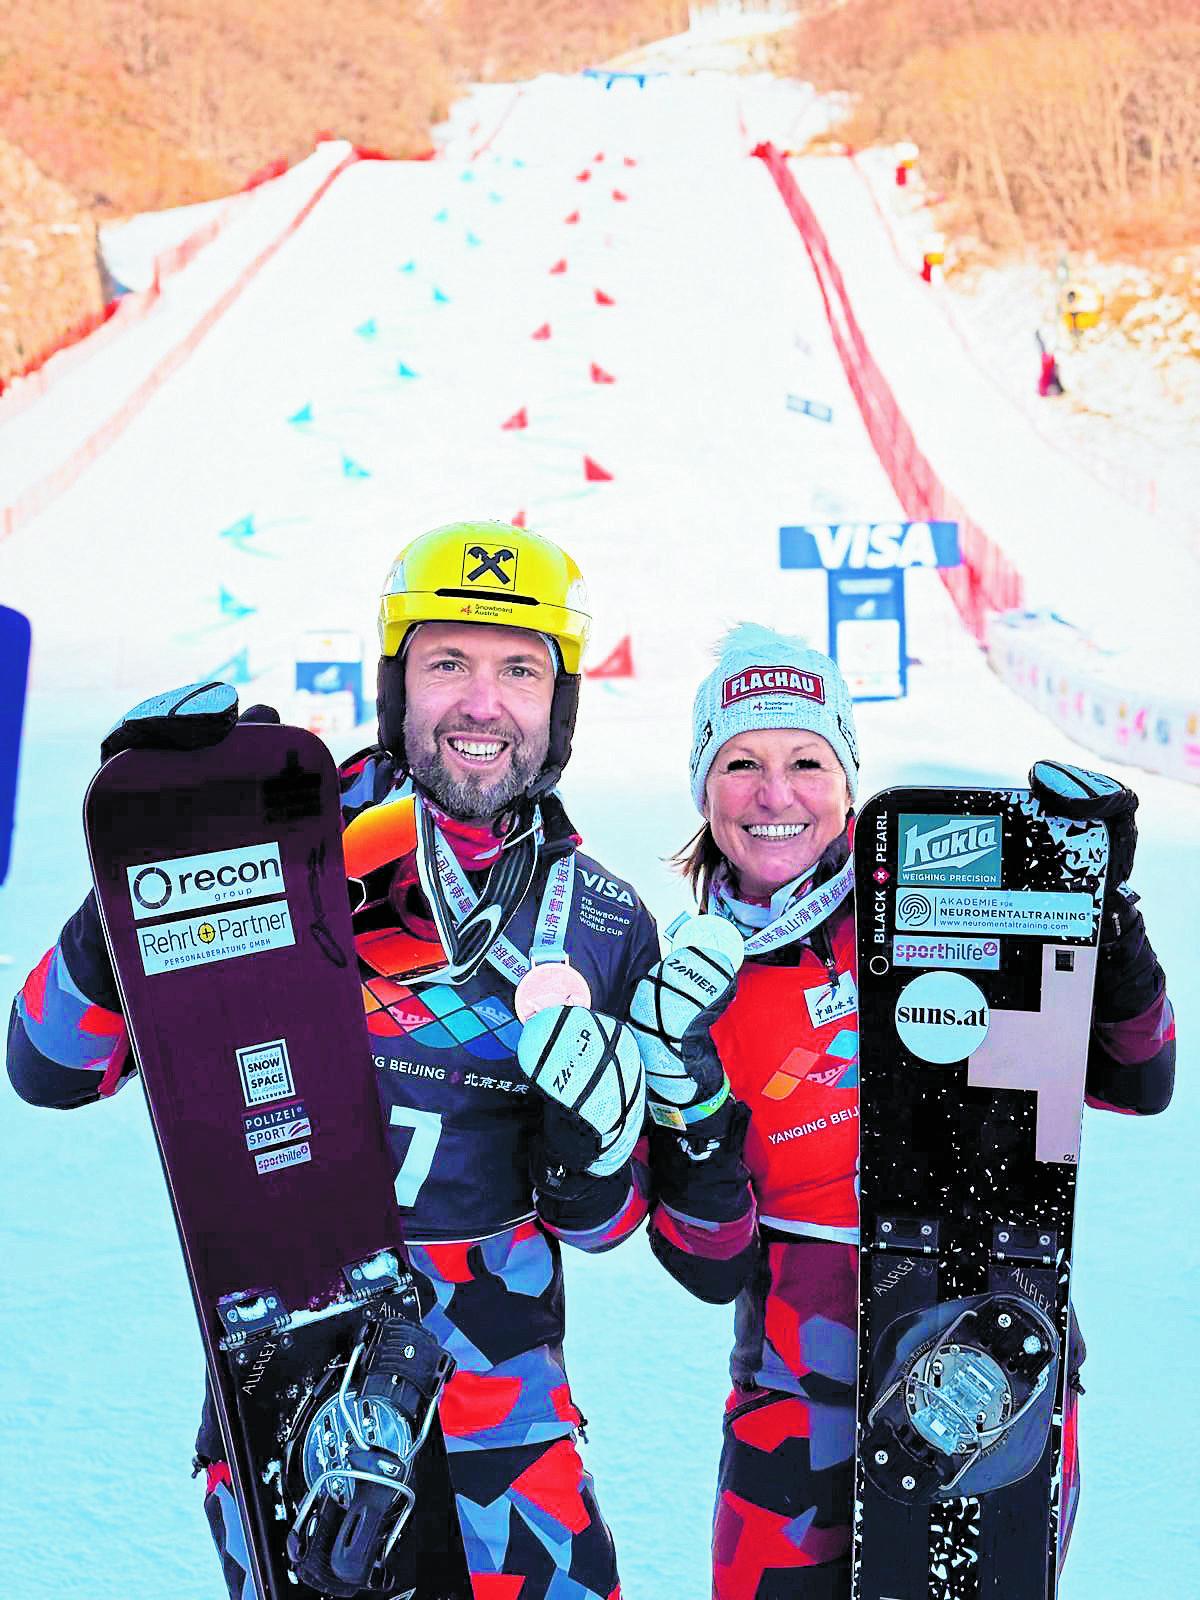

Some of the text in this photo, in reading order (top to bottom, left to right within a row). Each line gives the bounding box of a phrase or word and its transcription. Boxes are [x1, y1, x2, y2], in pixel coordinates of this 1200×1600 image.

[803, 522, 938, 569] VISA
[474, 603, 513, 614] Snowboard
[474, 609, 499, 617] Austria
[731, 671, 815, 696] FLACHAU
[902, 820, 998, 868] Kukla
[178, 857, 281, 895] recon
[576, 867, 635, 907] VISA
[873, 810, 888, 944] BLACK PEARL
[902, 873, 997, 883] WEIGHING PRECISION
[214, 886, 253, 901] group
[939, 897, 998, 907] AKADEMIE
[580, 903, 630, 925] SNOWBOARD
[580, 911, 605, 925] ALPINE
[939, 920, 1069, 930] www.neuromentaltraining.com
[142, 911, 287, 957] Rehrl Partner
[579, 916, 623, 937] WORLD CUP
[164, 938, 271, 966] PERSONALBERATUNG GMBH
[895, 943, 984, 962] sporthilfe
[897, 1005, 988, 1027] suns.at
[247, 1057, 281, 1073] SNOW
[389, 1059, 446, 1080] BEIJING
[250, 1072, 284, 1089] SPACE
[245, 1108, 296, 1129] POLIZEI
[248, 1127, 286, 1145] SPORT
[768, 1117, 827, 1145] YANQING
[258, 1147, 302, 1171] sporthilfe
[389, 1104, 443, 1208] 7
[873, 1256, 916, 1297] ALLFLEX
[1010, 1266, 1052, 1313] ALLFLEX
[241, 1341, 278, 1395] ALLFLEX
